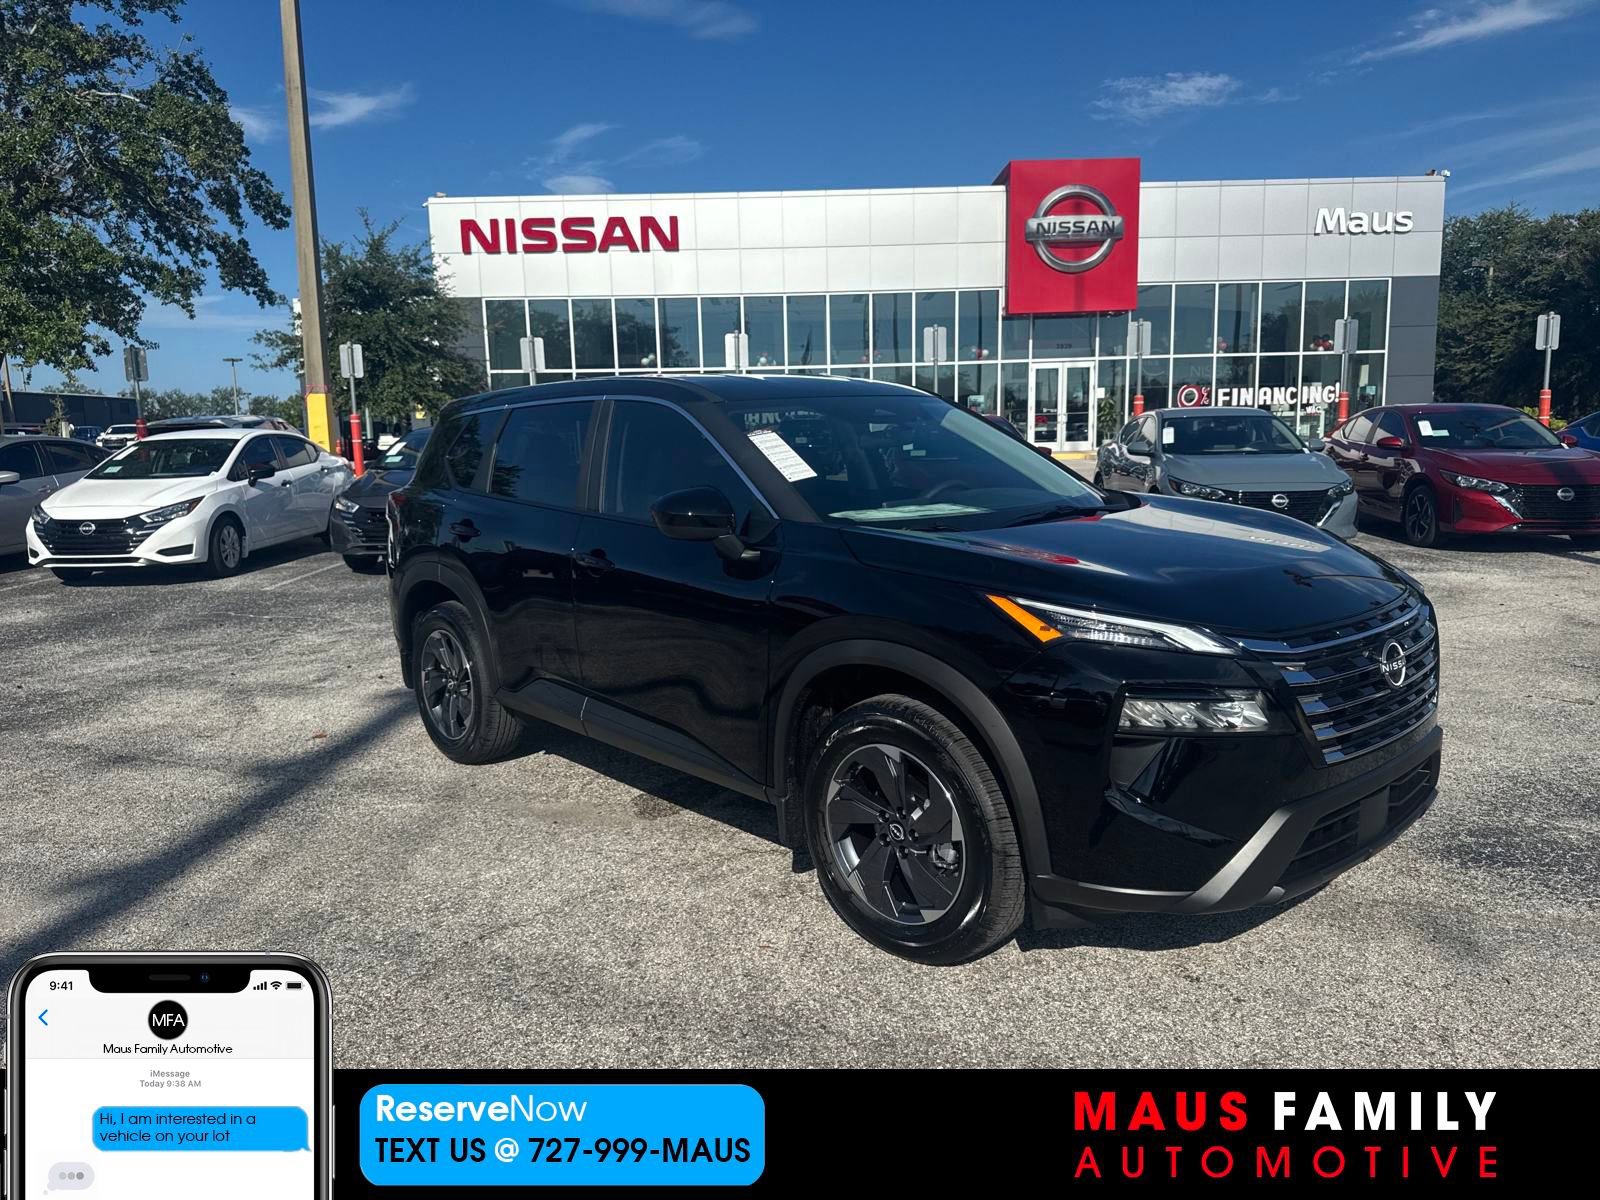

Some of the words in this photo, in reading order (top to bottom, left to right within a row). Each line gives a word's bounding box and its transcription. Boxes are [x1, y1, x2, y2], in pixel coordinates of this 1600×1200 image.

[1036, 220, 1115, 234] NISSAN
[1314, 207, 1414, 236] Maus
[460, 216, 680, 255] NISSAN
[1217, 382, 1340, 407] FINANCING!
